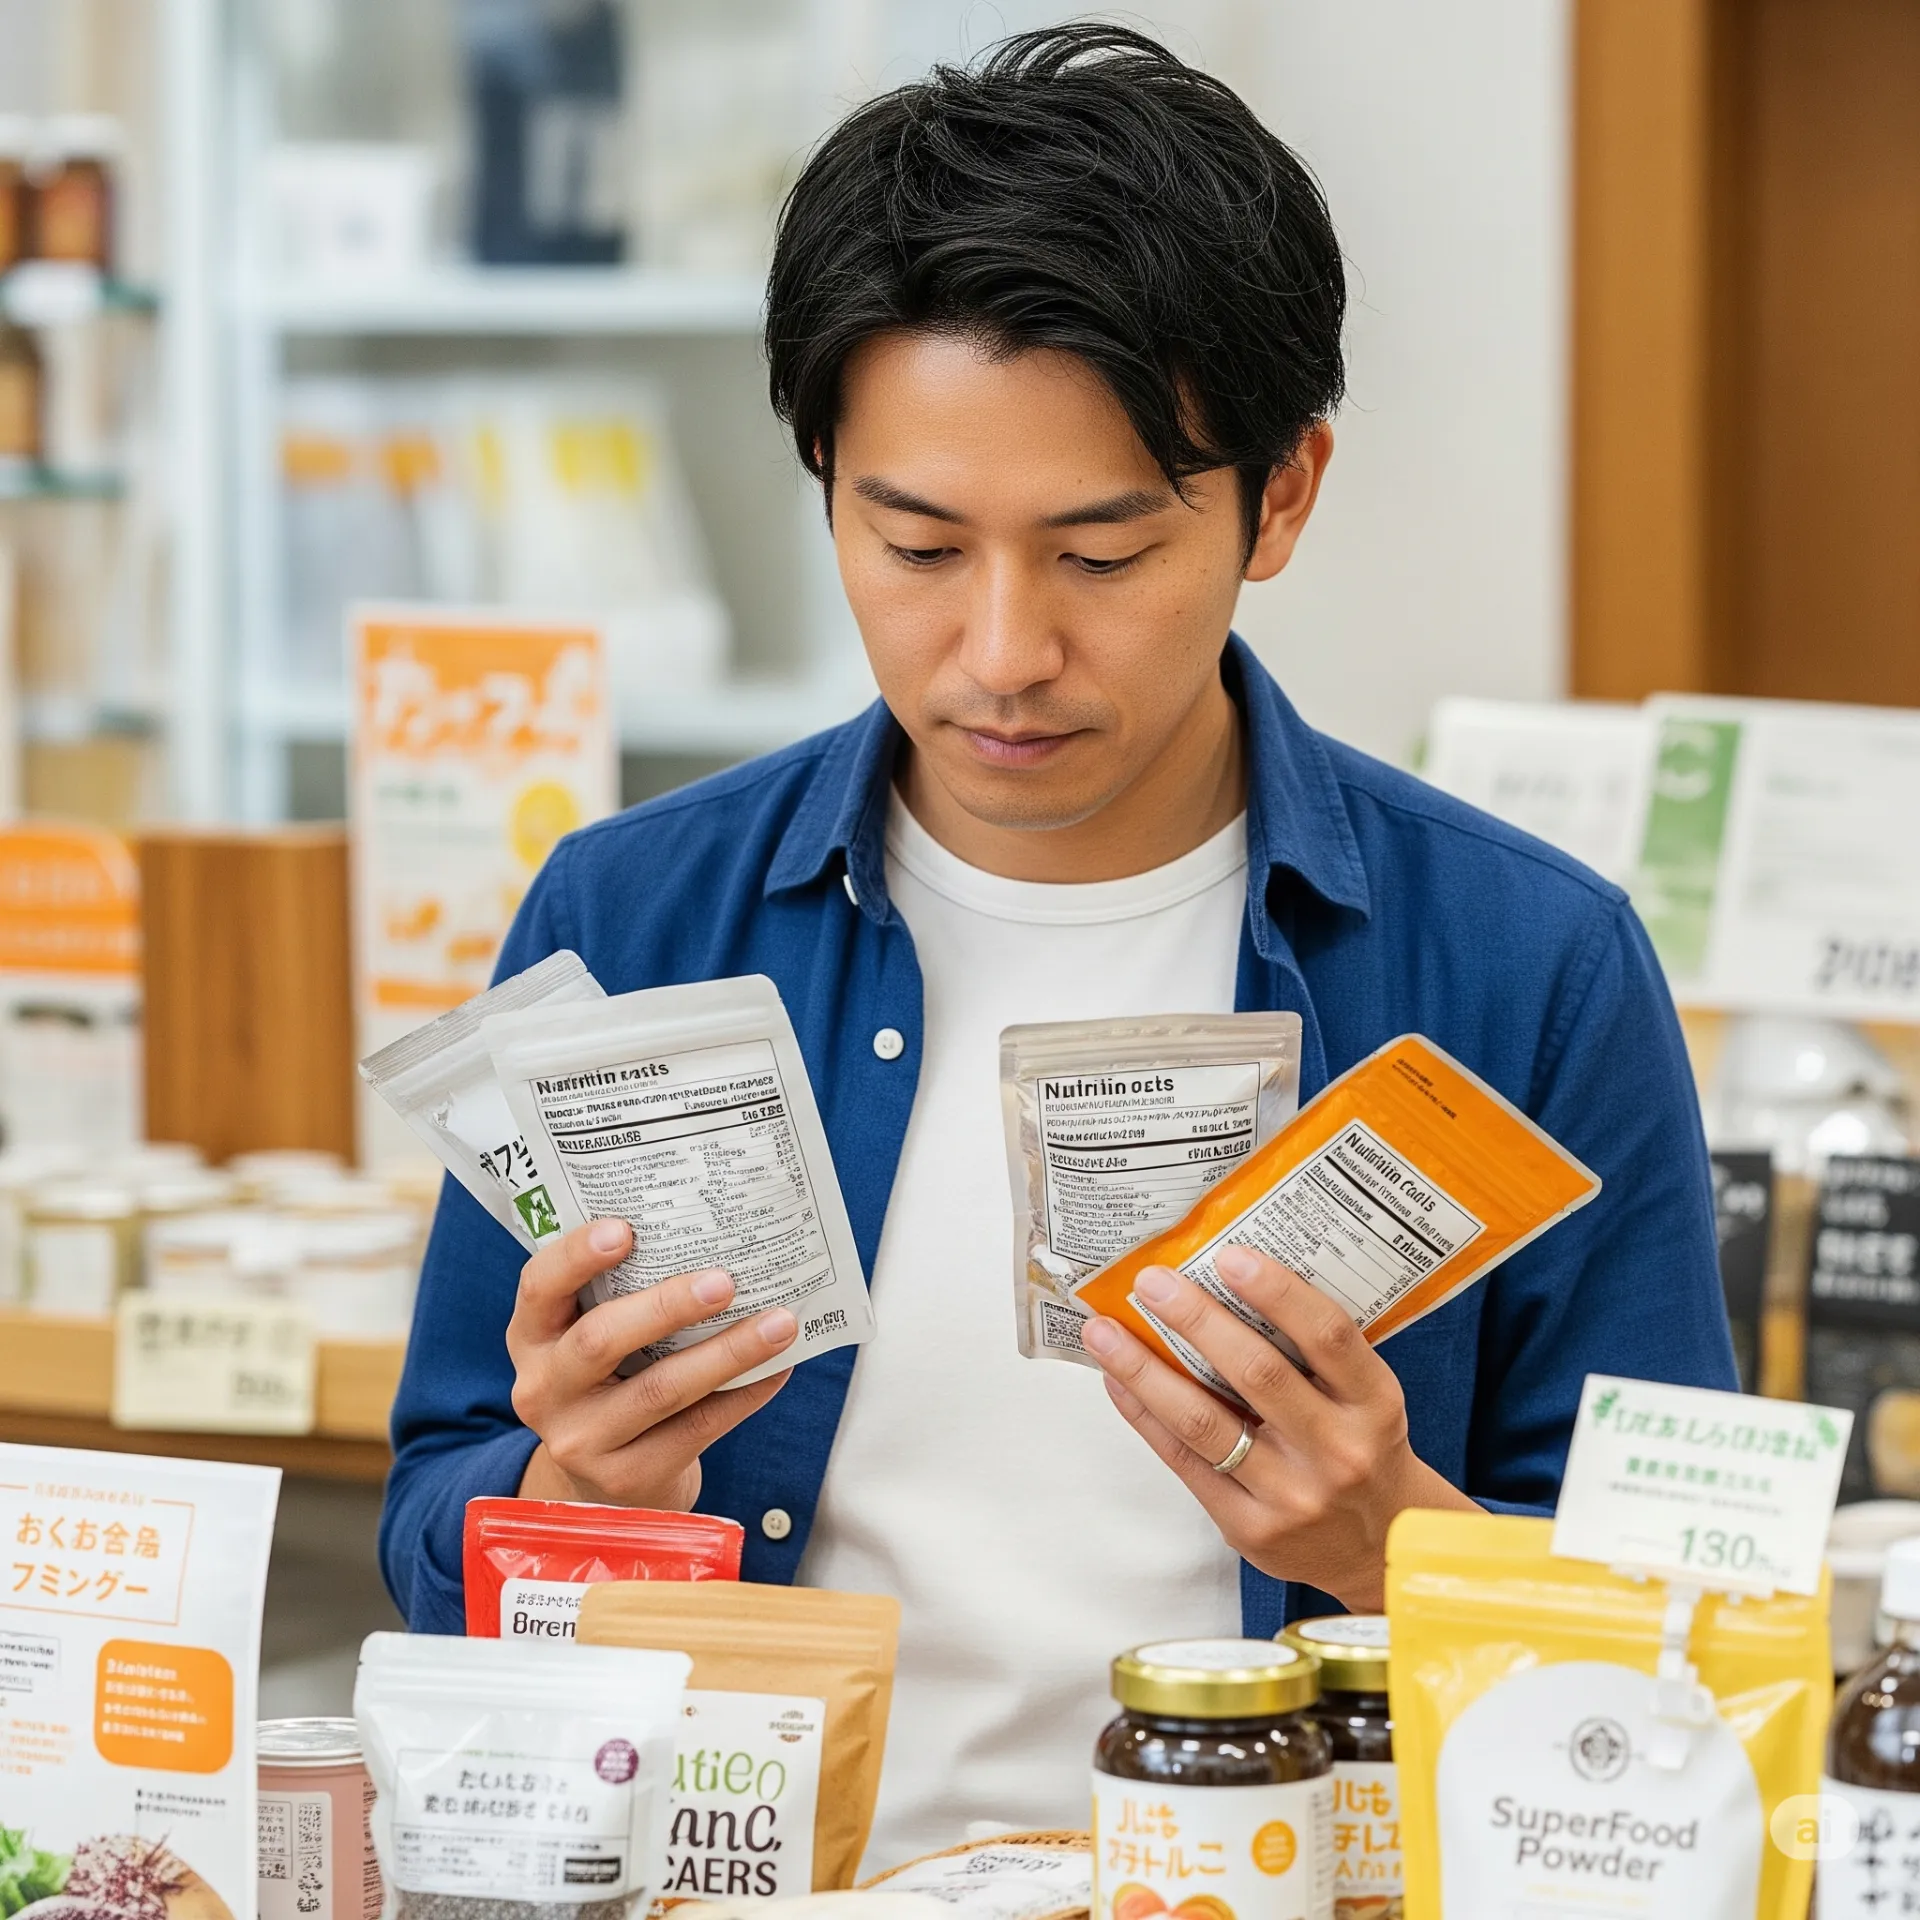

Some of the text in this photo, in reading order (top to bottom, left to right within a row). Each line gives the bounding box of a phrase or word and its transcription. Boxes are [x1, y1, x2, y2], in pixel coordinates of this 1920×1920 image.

[1680, 1527, 1756, 1571] 130
[1490, 1796, 1699, 1850] SuperFood
[1515, 1835, 1664, 1882] Powder
